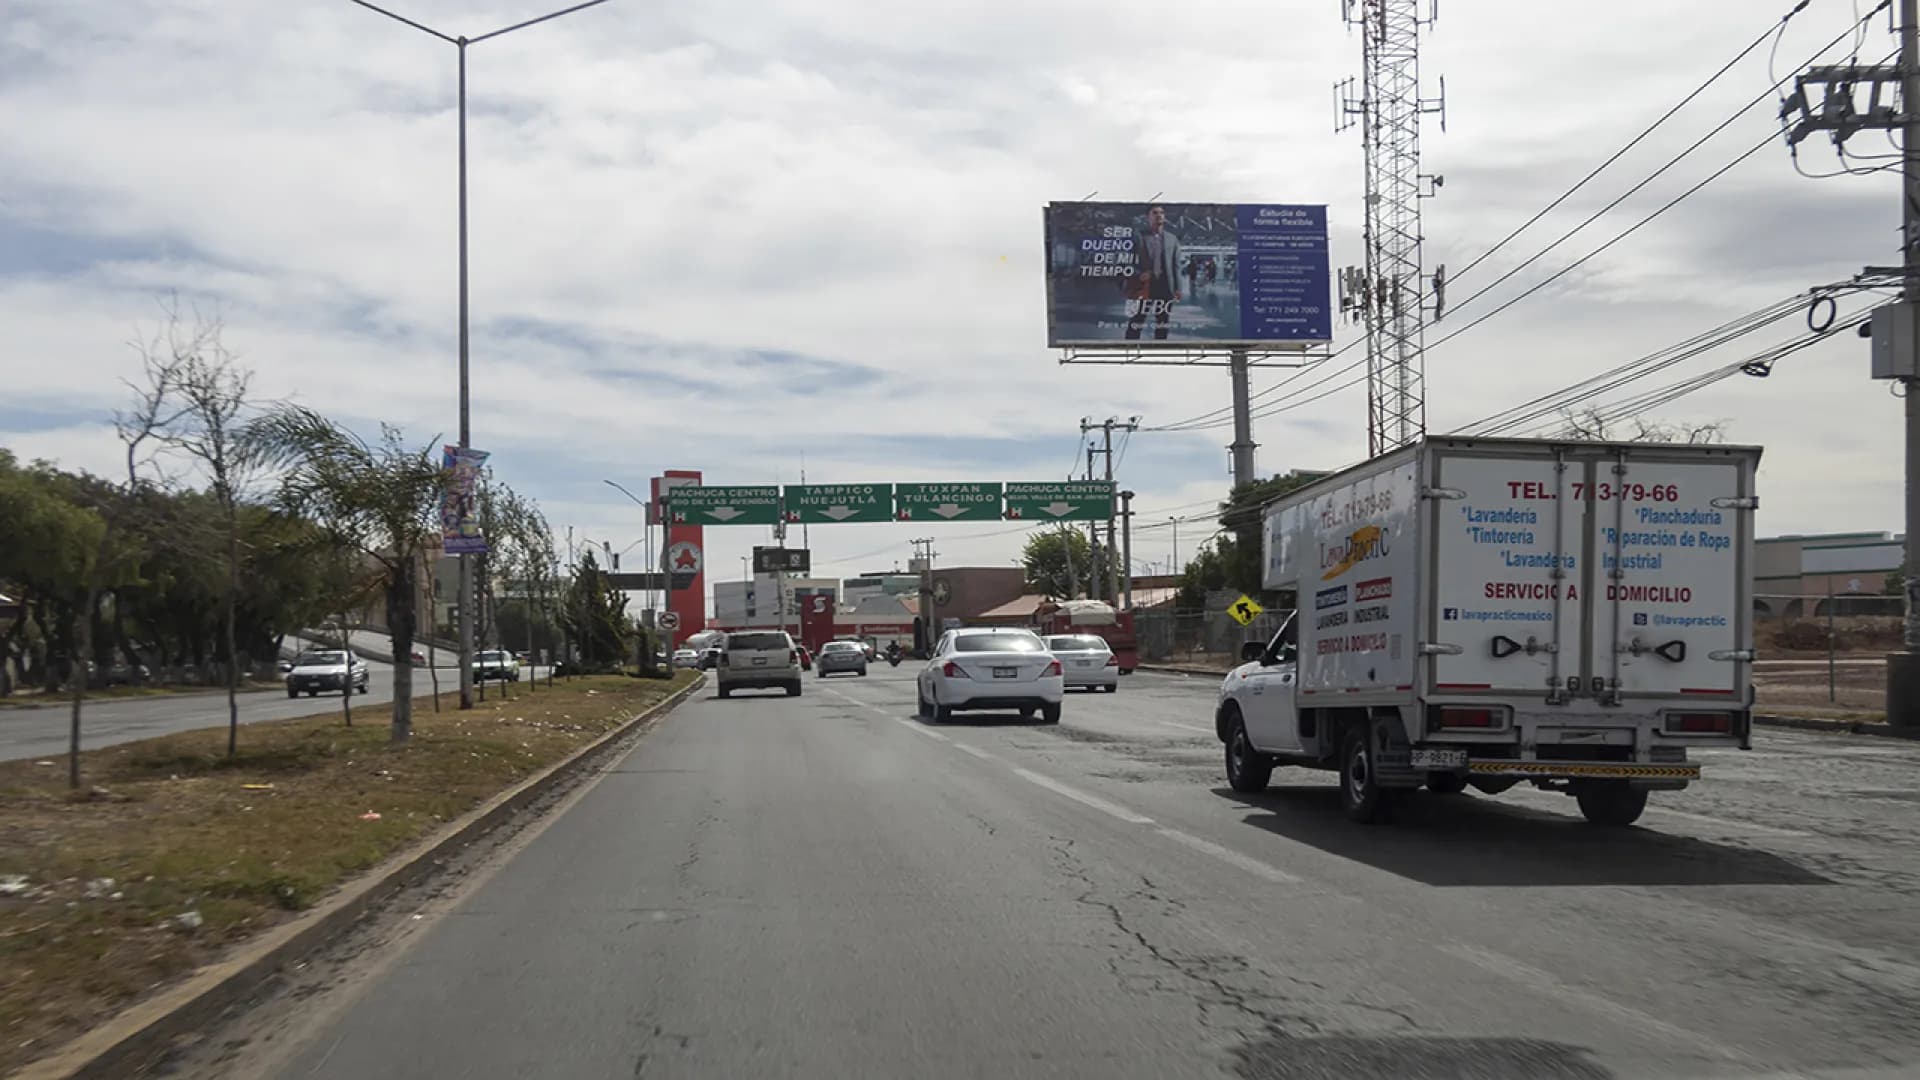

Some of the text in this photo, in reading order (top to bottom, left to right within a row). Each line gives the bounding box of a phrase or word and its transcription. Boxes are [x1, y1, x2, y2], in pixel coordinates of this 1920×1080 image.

[1103, 225, 1133, 238] SER
[1082, 238, 1134, 251] DUEÑO
[1094, 252, 1115, 264] DE
[1080, 265, 1135, 277] TIEMPO
[671, 488, 777, 497] PACHUCA CENTRO
[804, 486, 874, 495] TAMPICO
[919, 485, 981, 493] TUXPAN
[1008, 484, 1111, 493] PACHUCA CENTRO
[1507, 482, 1557, 499] TEL.
[800, 495, 877, 505] HUEJUTLA
[904, 494, 995, 502] TULANCINGO
[1680, 531, 1696, 547] de
[1699, 531, 1731, 552] Ropa
[1566, 584, 1578, 600] A
[1606, 584, 1691, 602] DOMICILIO
[1462, 608, 1553, 622] lavapracticmexico
[1652, 613, 1727, 627] @lavapractic
